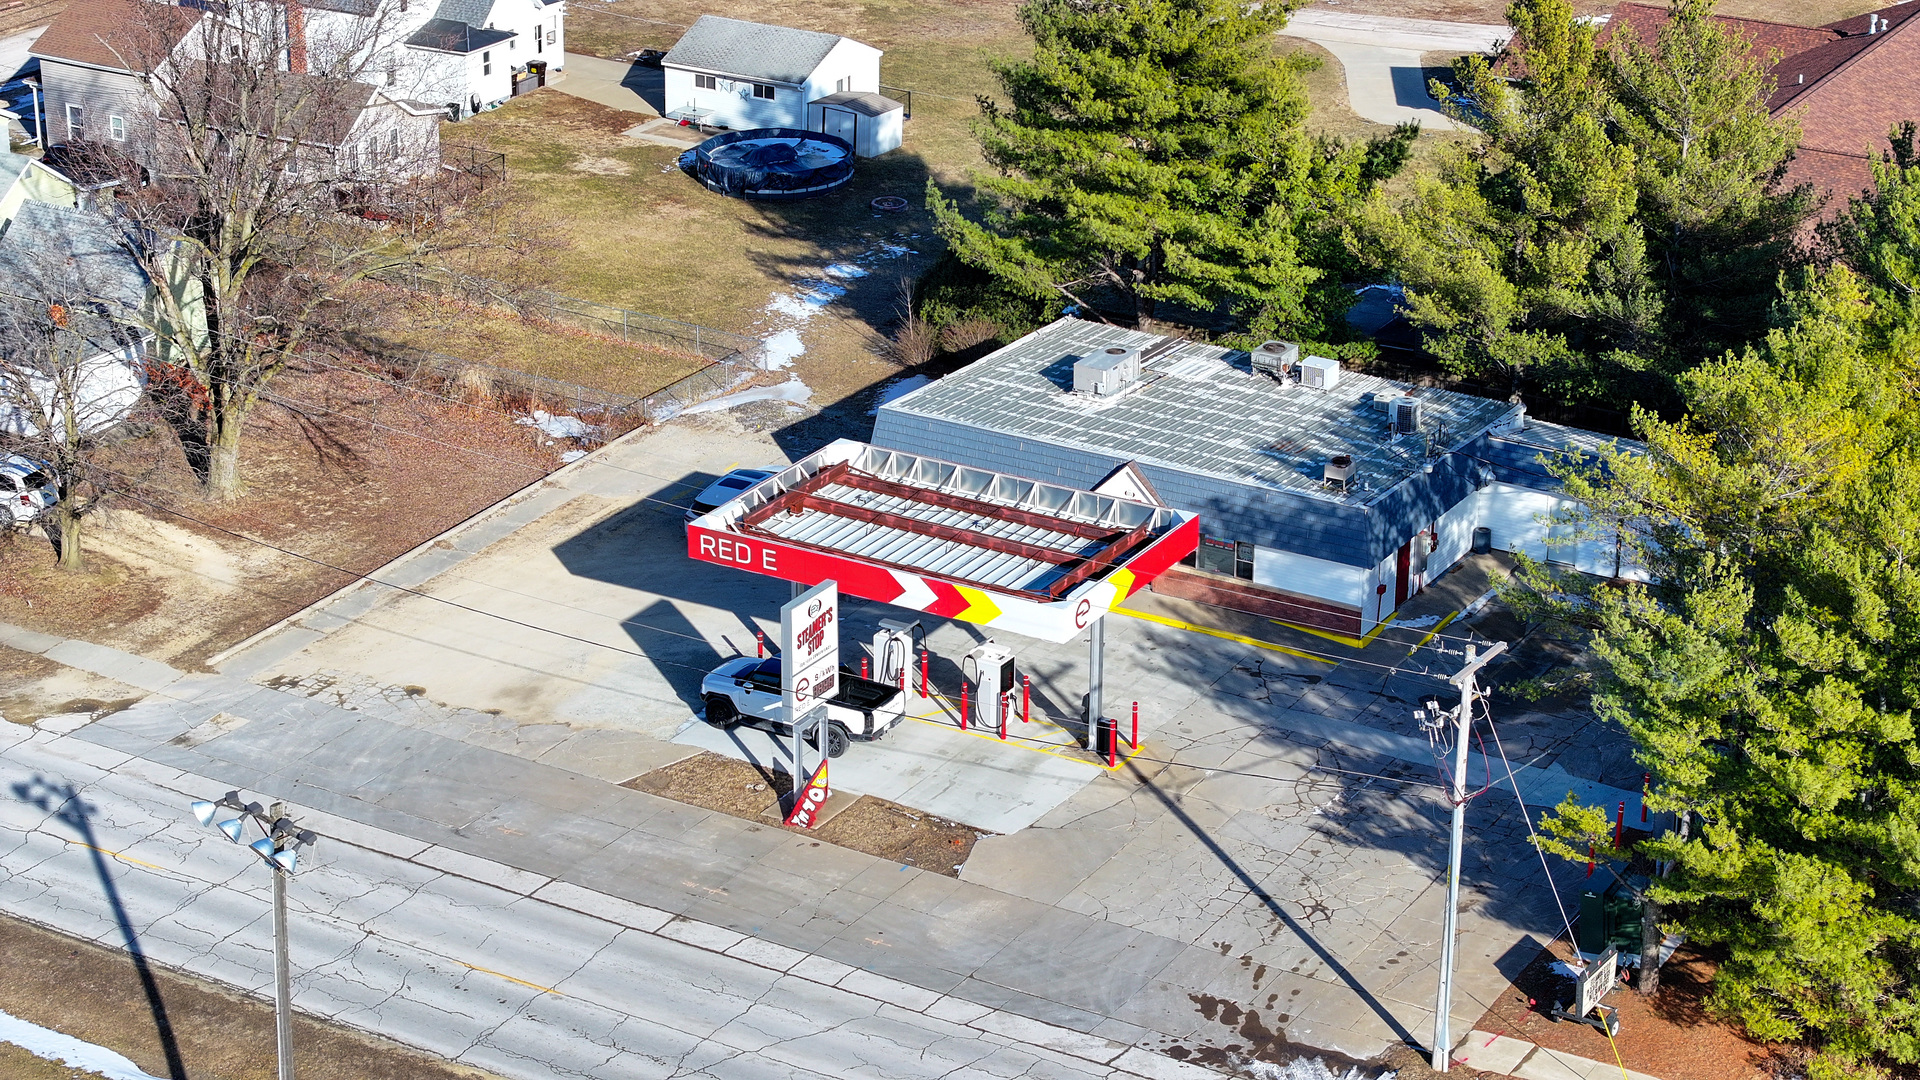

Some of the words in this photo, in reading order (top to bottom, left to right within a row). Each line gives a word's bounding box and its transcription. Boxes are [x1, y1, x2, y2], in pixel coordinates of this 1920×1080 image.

[700, 534, 751, 564] RED
[762, 548, 777, 571] E
[797, 607, 833, 650] STEAMER'S
[807, 629, 825, 656] STOP
